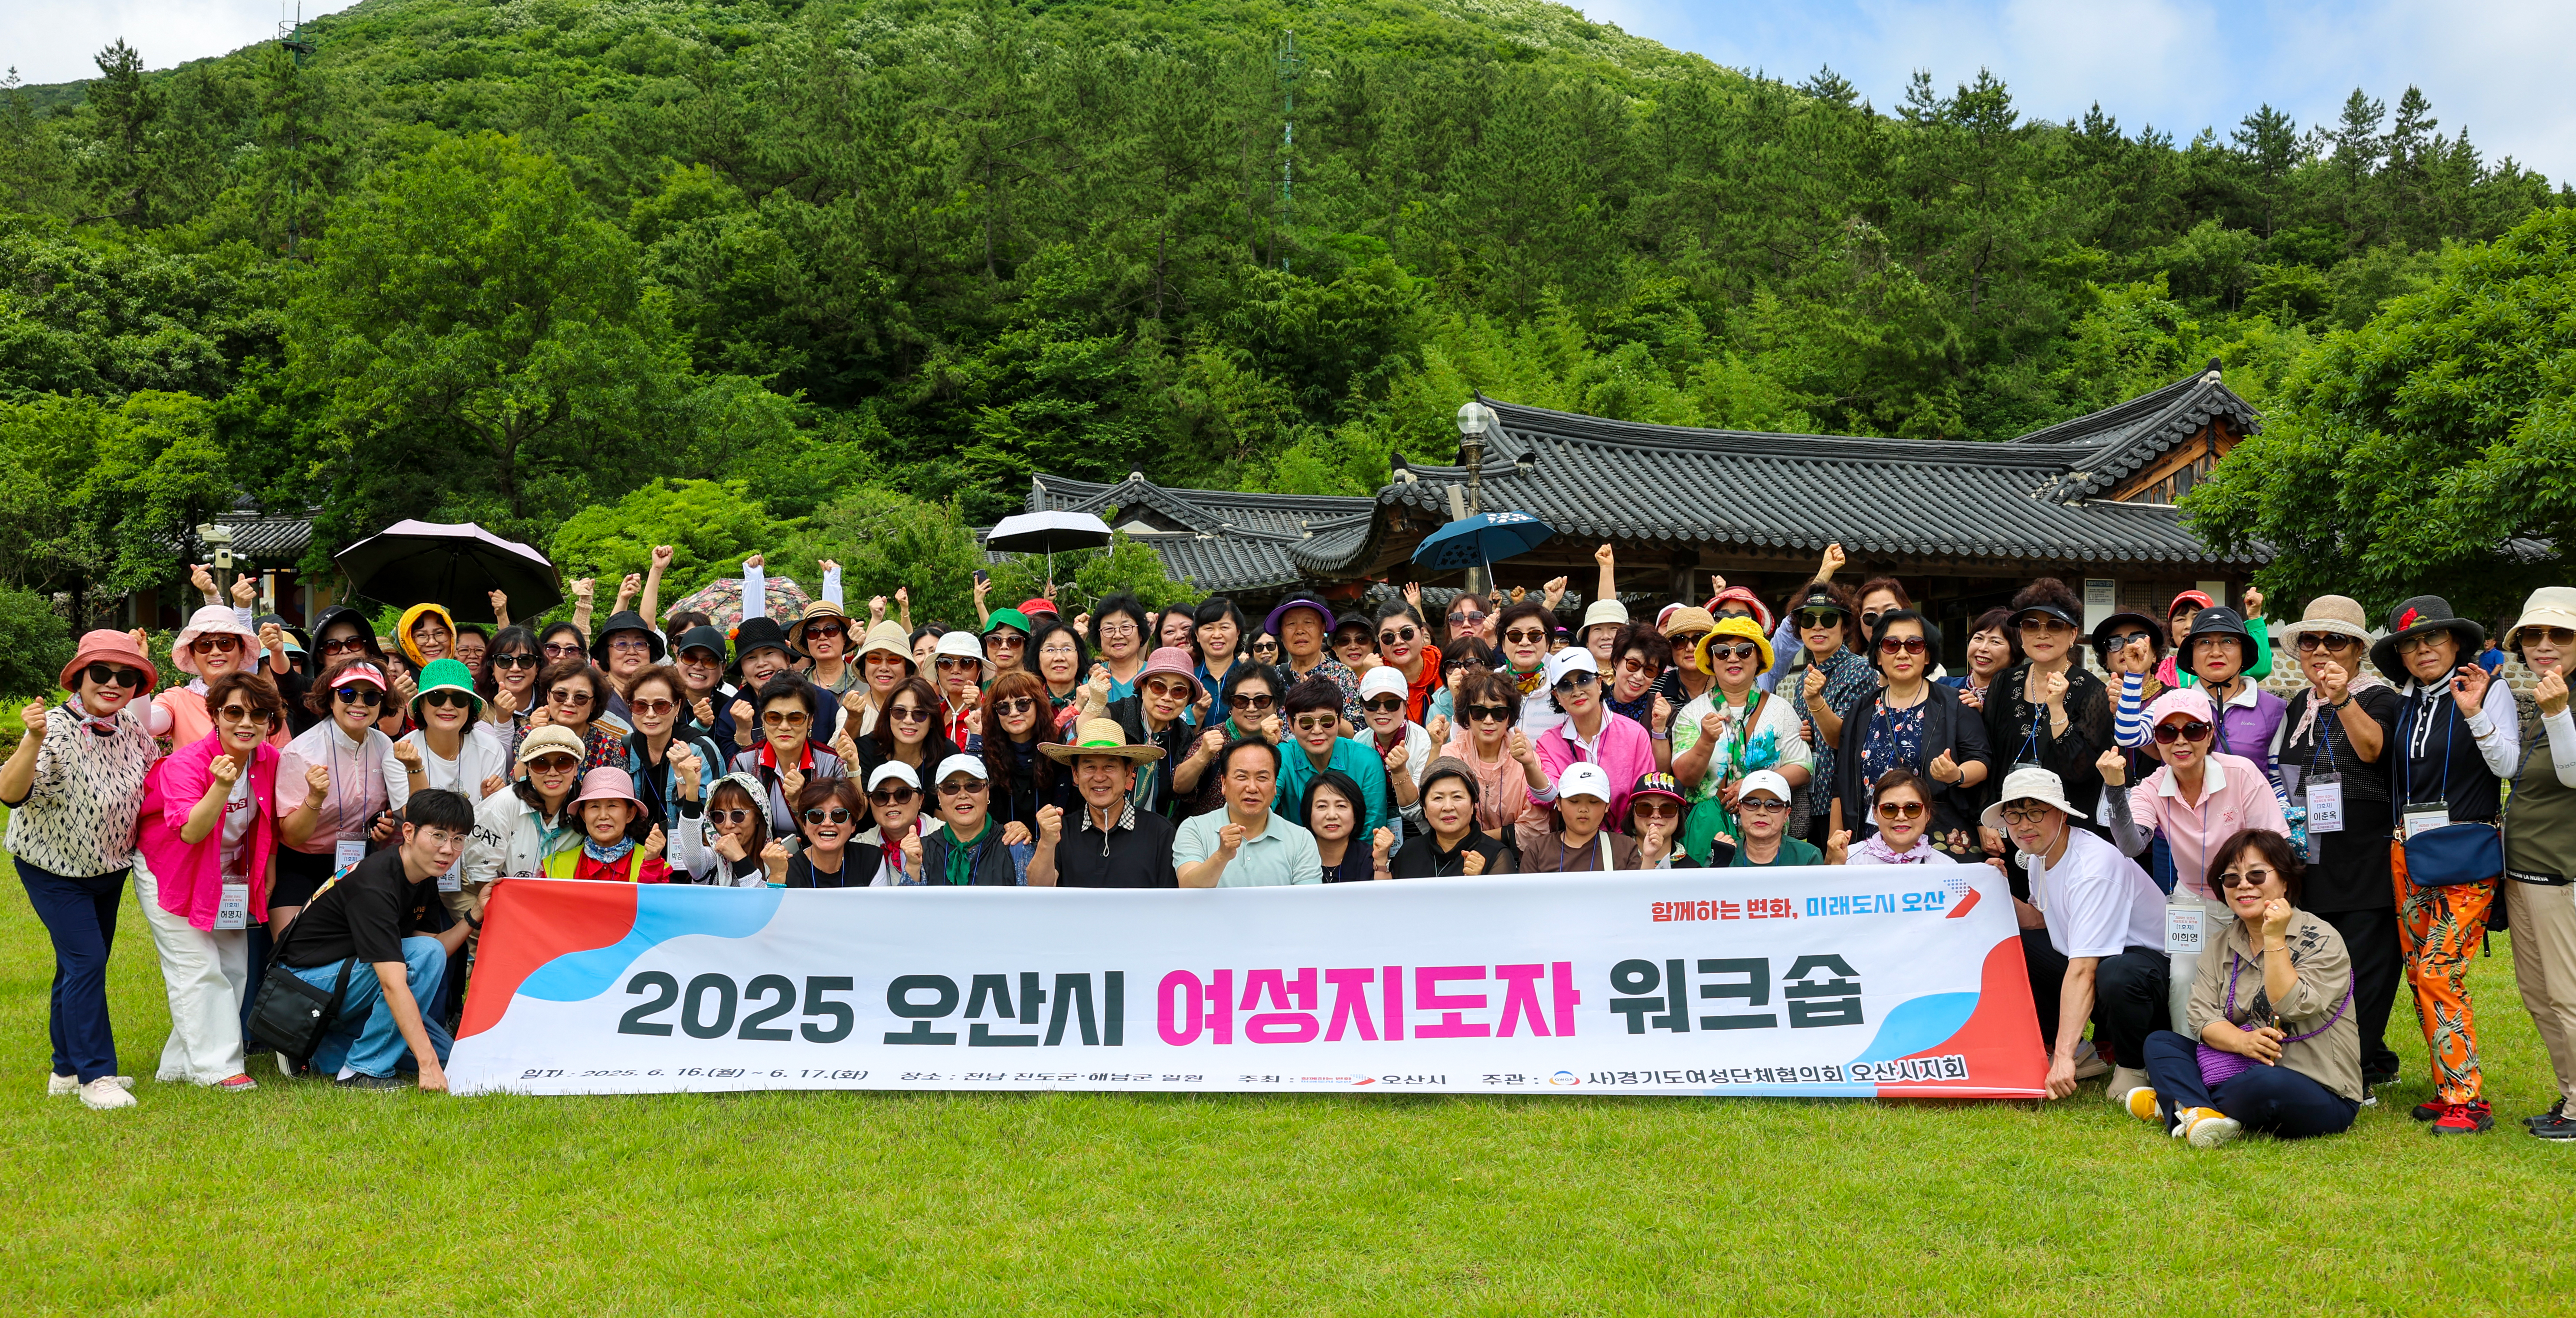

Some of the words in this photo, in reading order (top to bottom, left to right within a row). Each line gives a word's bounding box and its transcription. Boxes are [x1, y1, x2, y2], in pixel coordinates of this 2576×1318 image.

[2314, 811, 2337, 821] 이춘옥
[472, 825, 501, 847] CAT
[1651, 900, 1740, 922] 함께하는
[1747, 897, 1798, 920] 변화,
[1806, 894, 1896, 917] 미래도시
[1902, 891, 1946, 912] 오산
[221, 910, 242, 919] 허명자
[2172, 933, 2198, 942] 이희영
[618, 970, 854, 1044] 2025
[883, 971, 1125, 1047] 오산시
[1157, 961, 1580, 1046] 여성지도자
[1609, 954, 1864, 1034] 워크숍
[520, 1069, 564, 1079] 일자
[770, 1069, 788, 1078] 6.
[1588, 1065, 1844, 1085] 사)경기도여성단체협의회
[1851, 1057, 1965, 1081] 오산시지회
[901, 1072, 941, 1080] 장소
[964, 1072, 1007, 1081] 전남
[1162, 1074, 1203, 1082] 일원
[1239, 1075, 1280, 1083] 주최
[1381, 1075, 1446, 1085] 오산시
[1482, 1073, 1526, 1085] 주관
